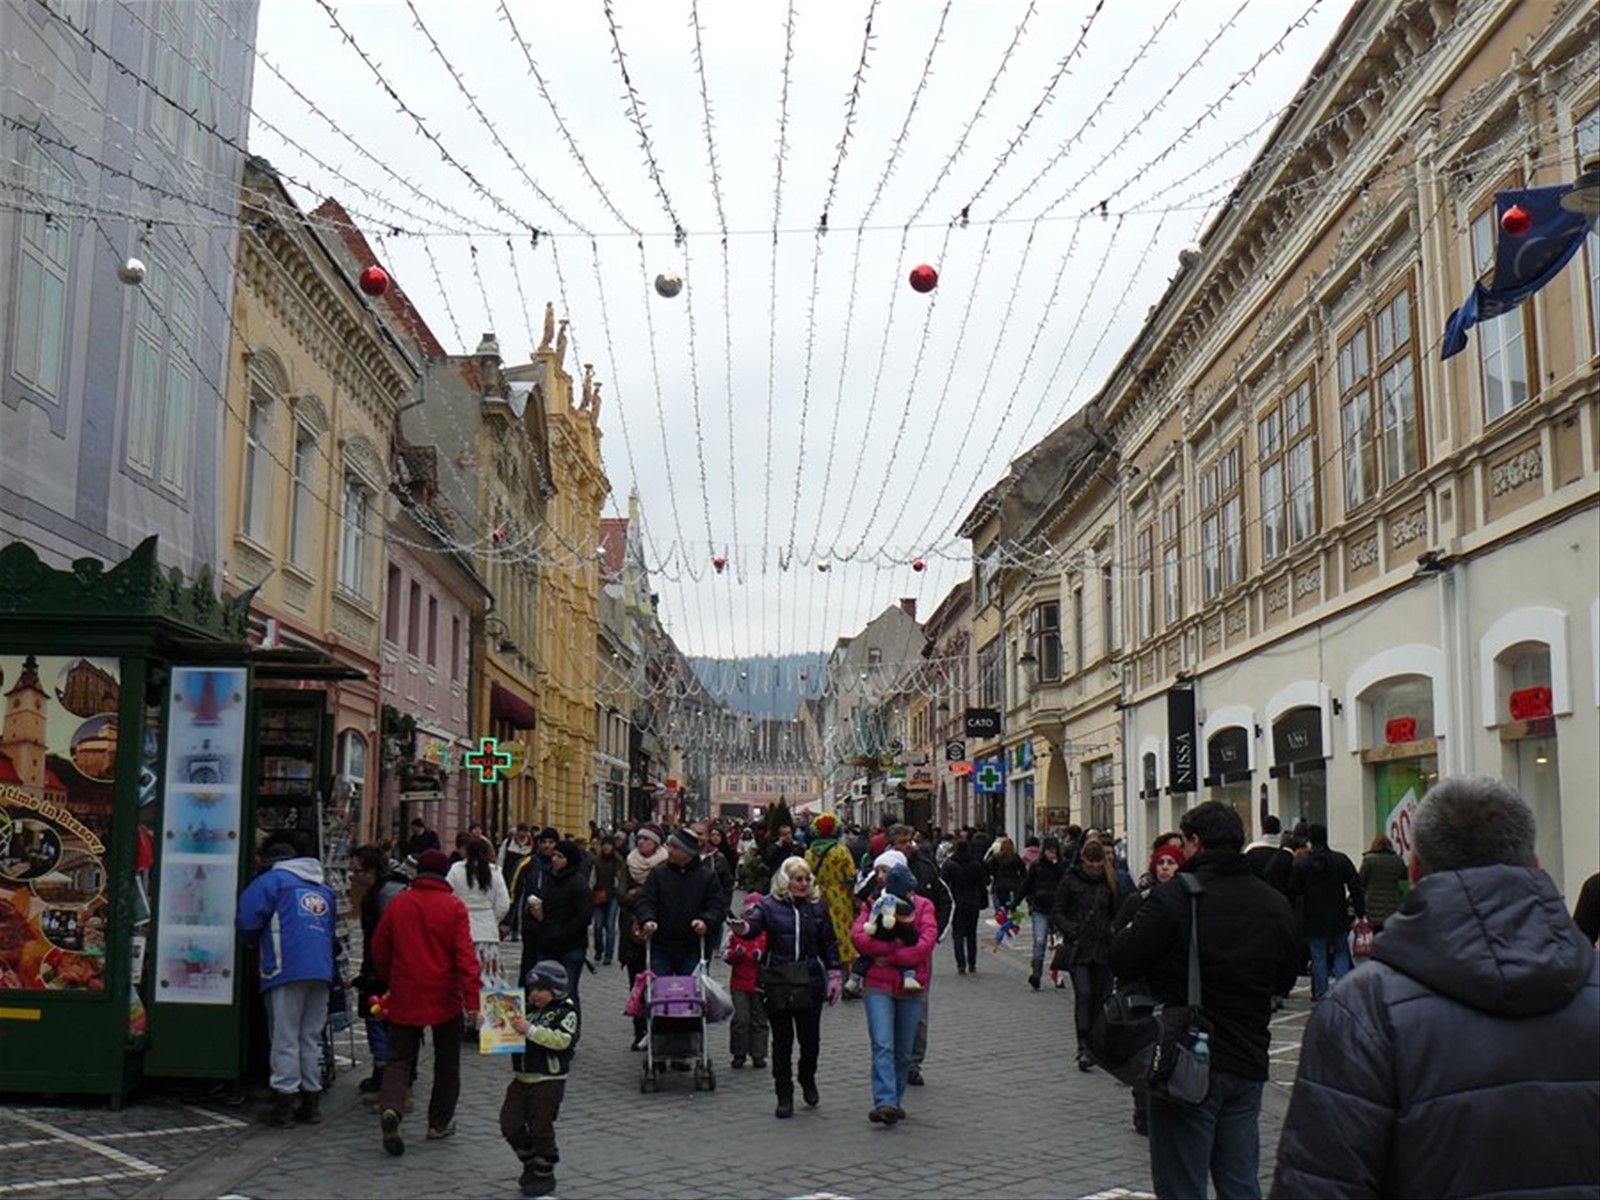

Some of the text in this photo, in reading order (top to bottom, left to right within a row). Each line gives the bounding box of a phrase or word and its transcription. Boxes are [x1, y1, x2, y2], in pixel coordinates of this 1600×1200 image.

[968, 718, 994, 727] CATO
[1175, 732, 1192, 784] NISSA
[912, 768, 931, 780] dm
[6, 785, 40, 810] time
[39, 801, 57, 819] in
